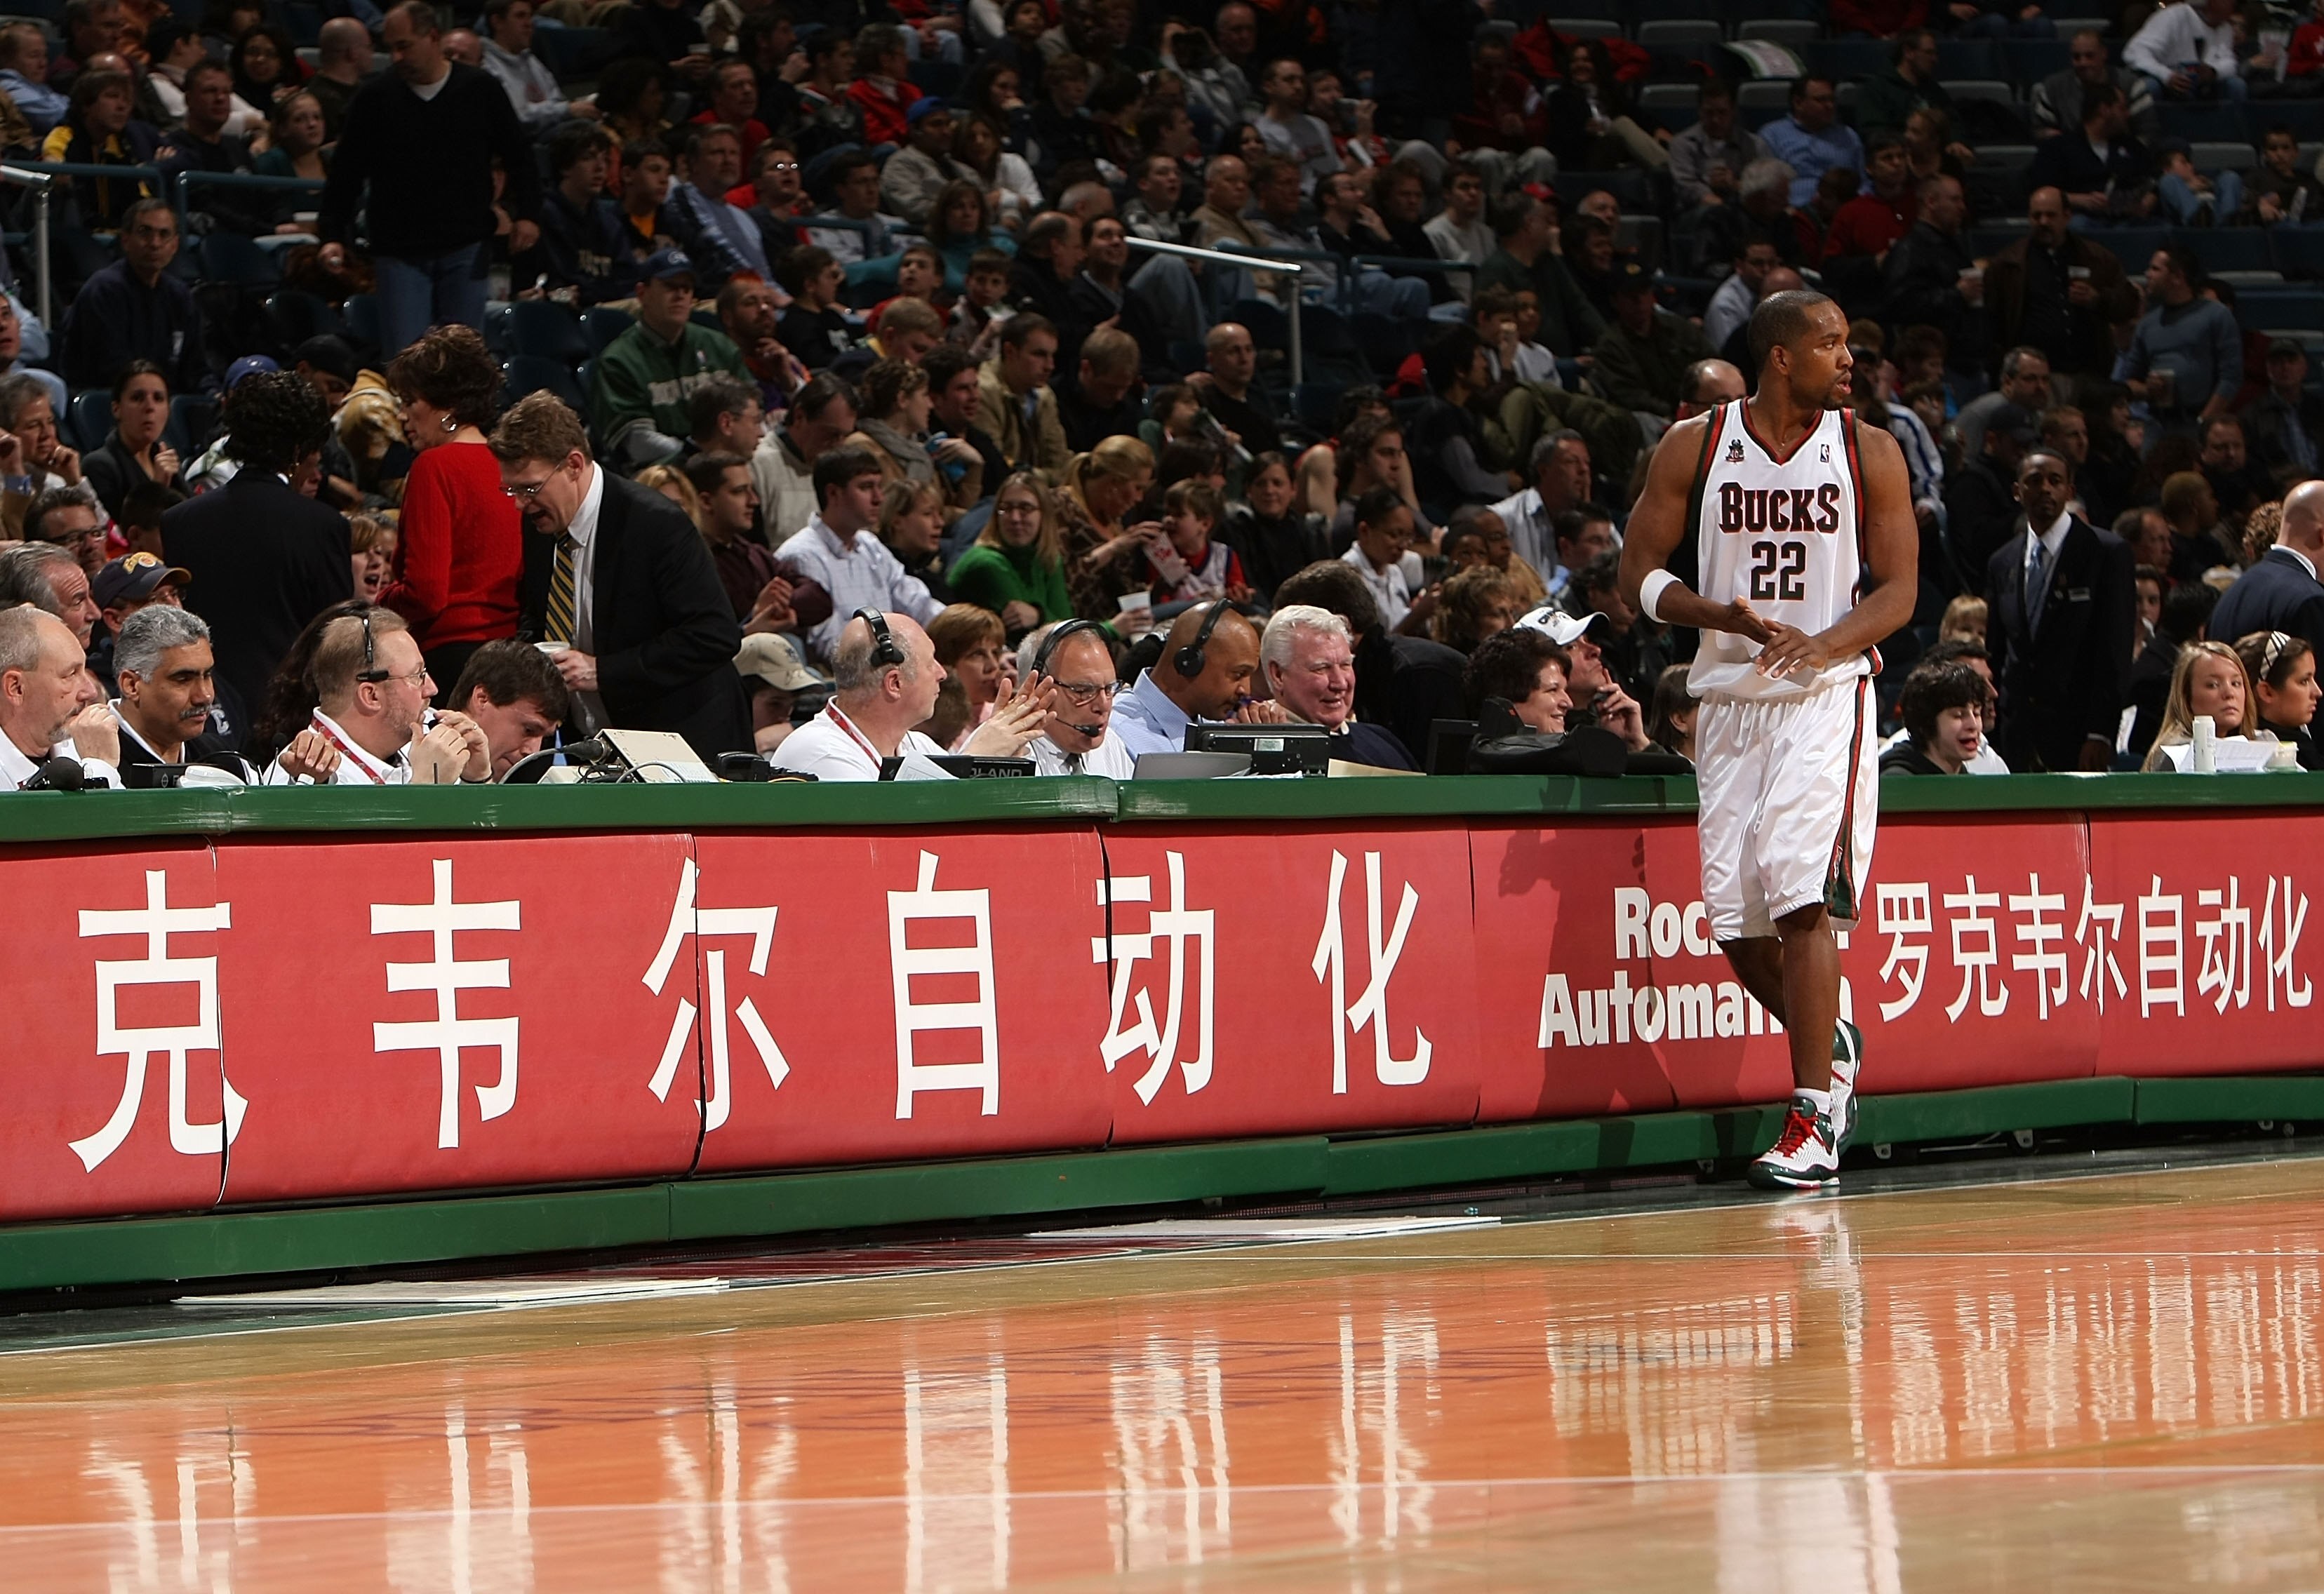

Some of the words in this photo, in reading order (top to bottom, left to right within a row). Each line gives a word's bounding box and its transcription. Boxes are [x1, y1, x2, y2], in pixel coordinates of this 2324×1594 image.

[1718, 482, 1841, 535] BUCKS
[1750, 540, 1807, 601] 22
[1876, 872, 2313, 1023] 罗克韦尔自动化
[68, 849, 1432, 1185] 克韦尔自动化
